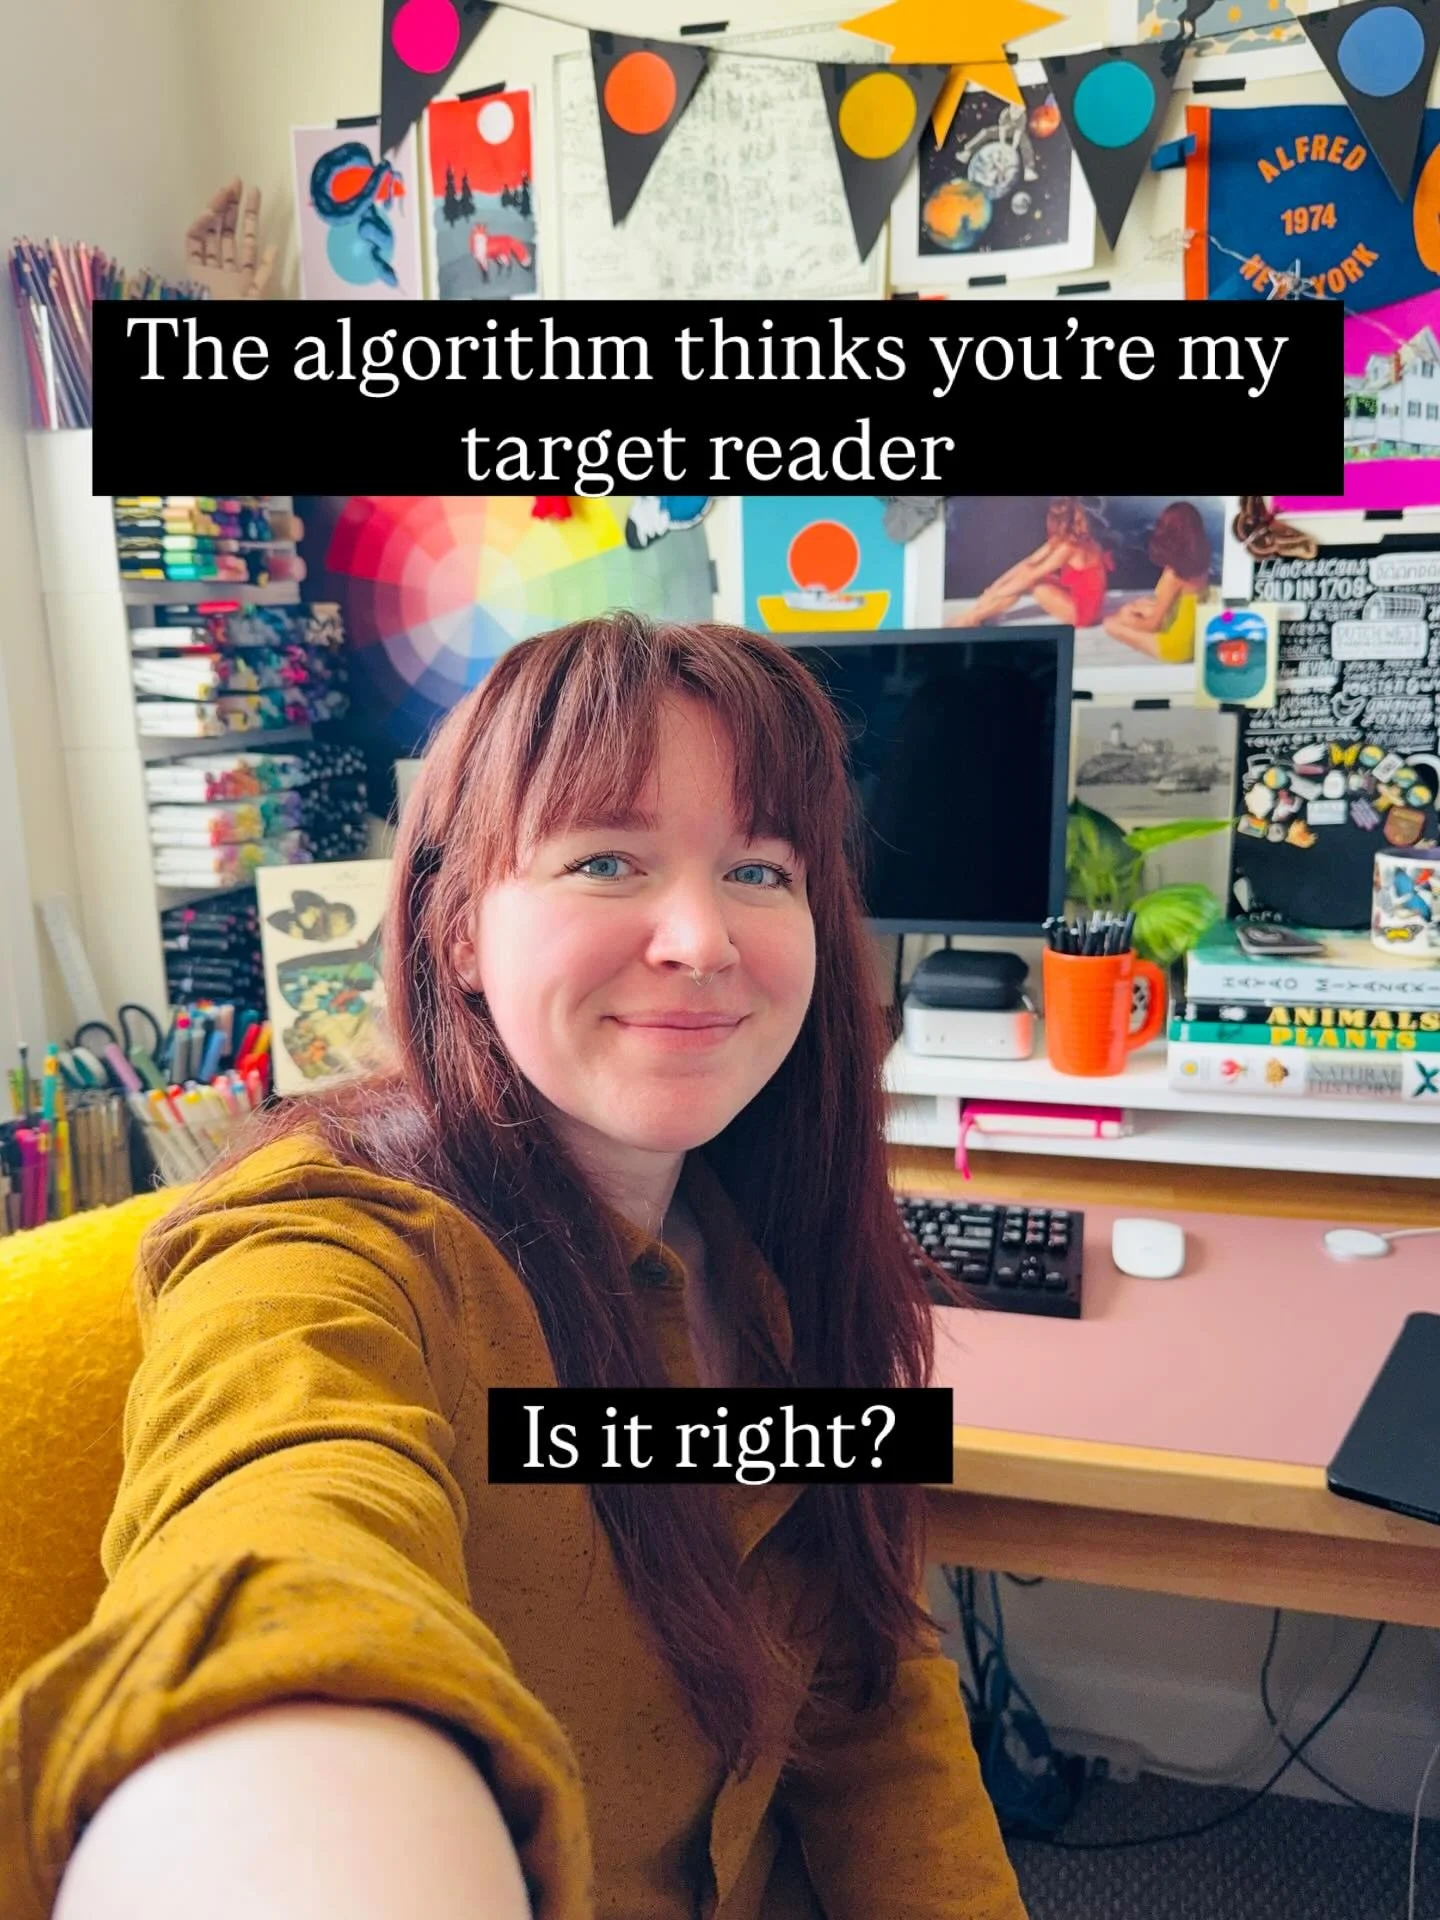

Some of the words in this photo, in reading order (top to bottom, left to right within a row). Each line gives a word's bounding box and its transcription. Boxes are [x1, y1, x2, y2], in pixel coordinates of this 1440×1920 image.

[1258, 134, 1367, 184] ALFRED
[1280, 203, 1337, 236] 1974
[1310, 241, 1380, 298] YORK
[1224, 977, 1298, 990] HAYAO
[1316, 978, 1440, 993] MIYAZAKI
[1266, 1005, 1440, 1032] ANIMALS
[1270, 1026, 1417, 1050] PLANTS
